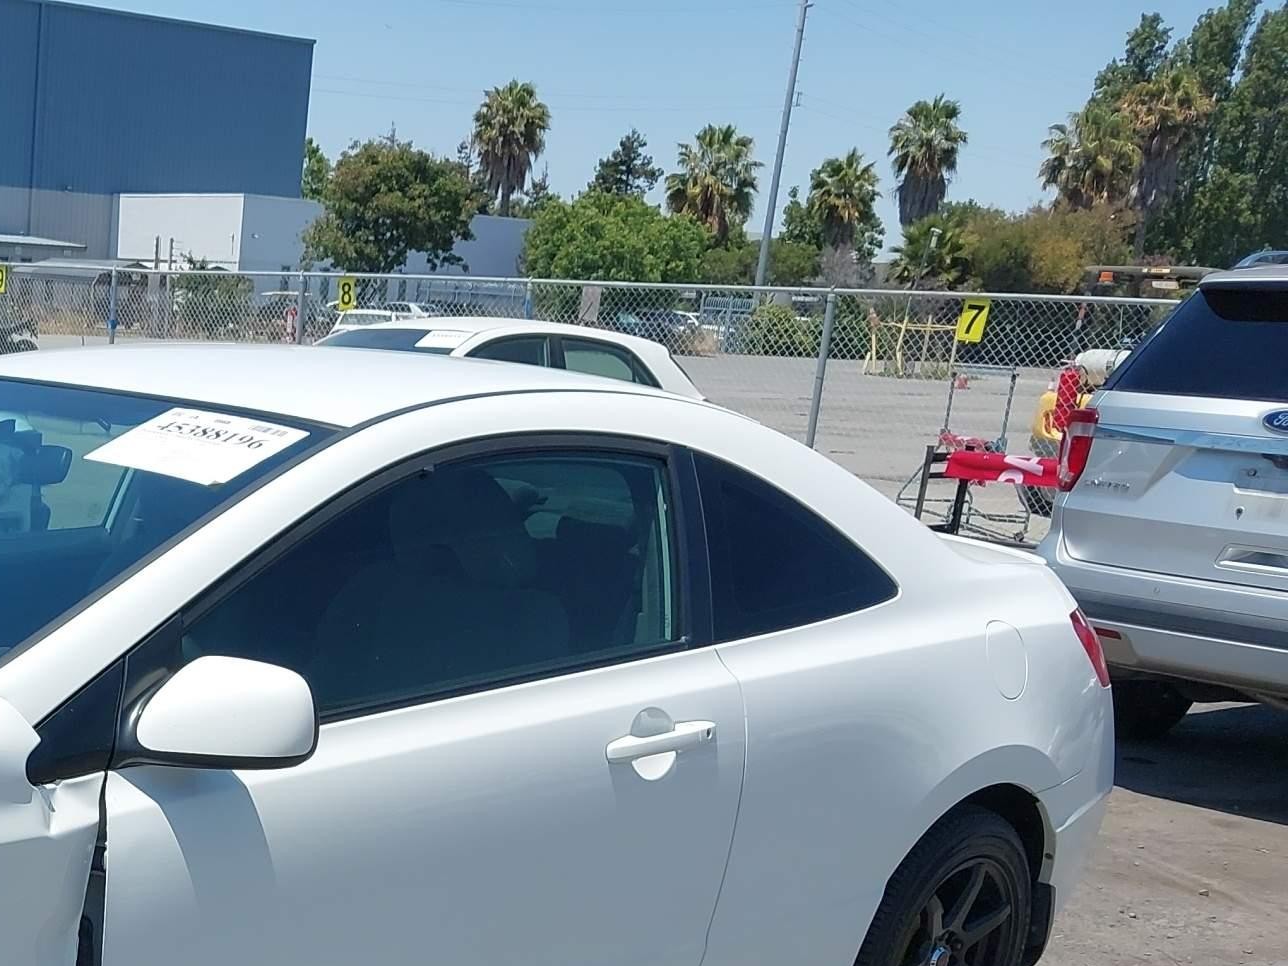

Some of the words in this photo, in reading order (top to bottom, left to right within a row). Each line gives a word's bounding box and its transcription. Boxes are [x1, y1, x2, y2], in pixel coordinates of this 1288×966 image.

[341, 282, 352, 306] 8
[964, 304, 986, 334] 7
[157, 421, 266, 449] 45388196
